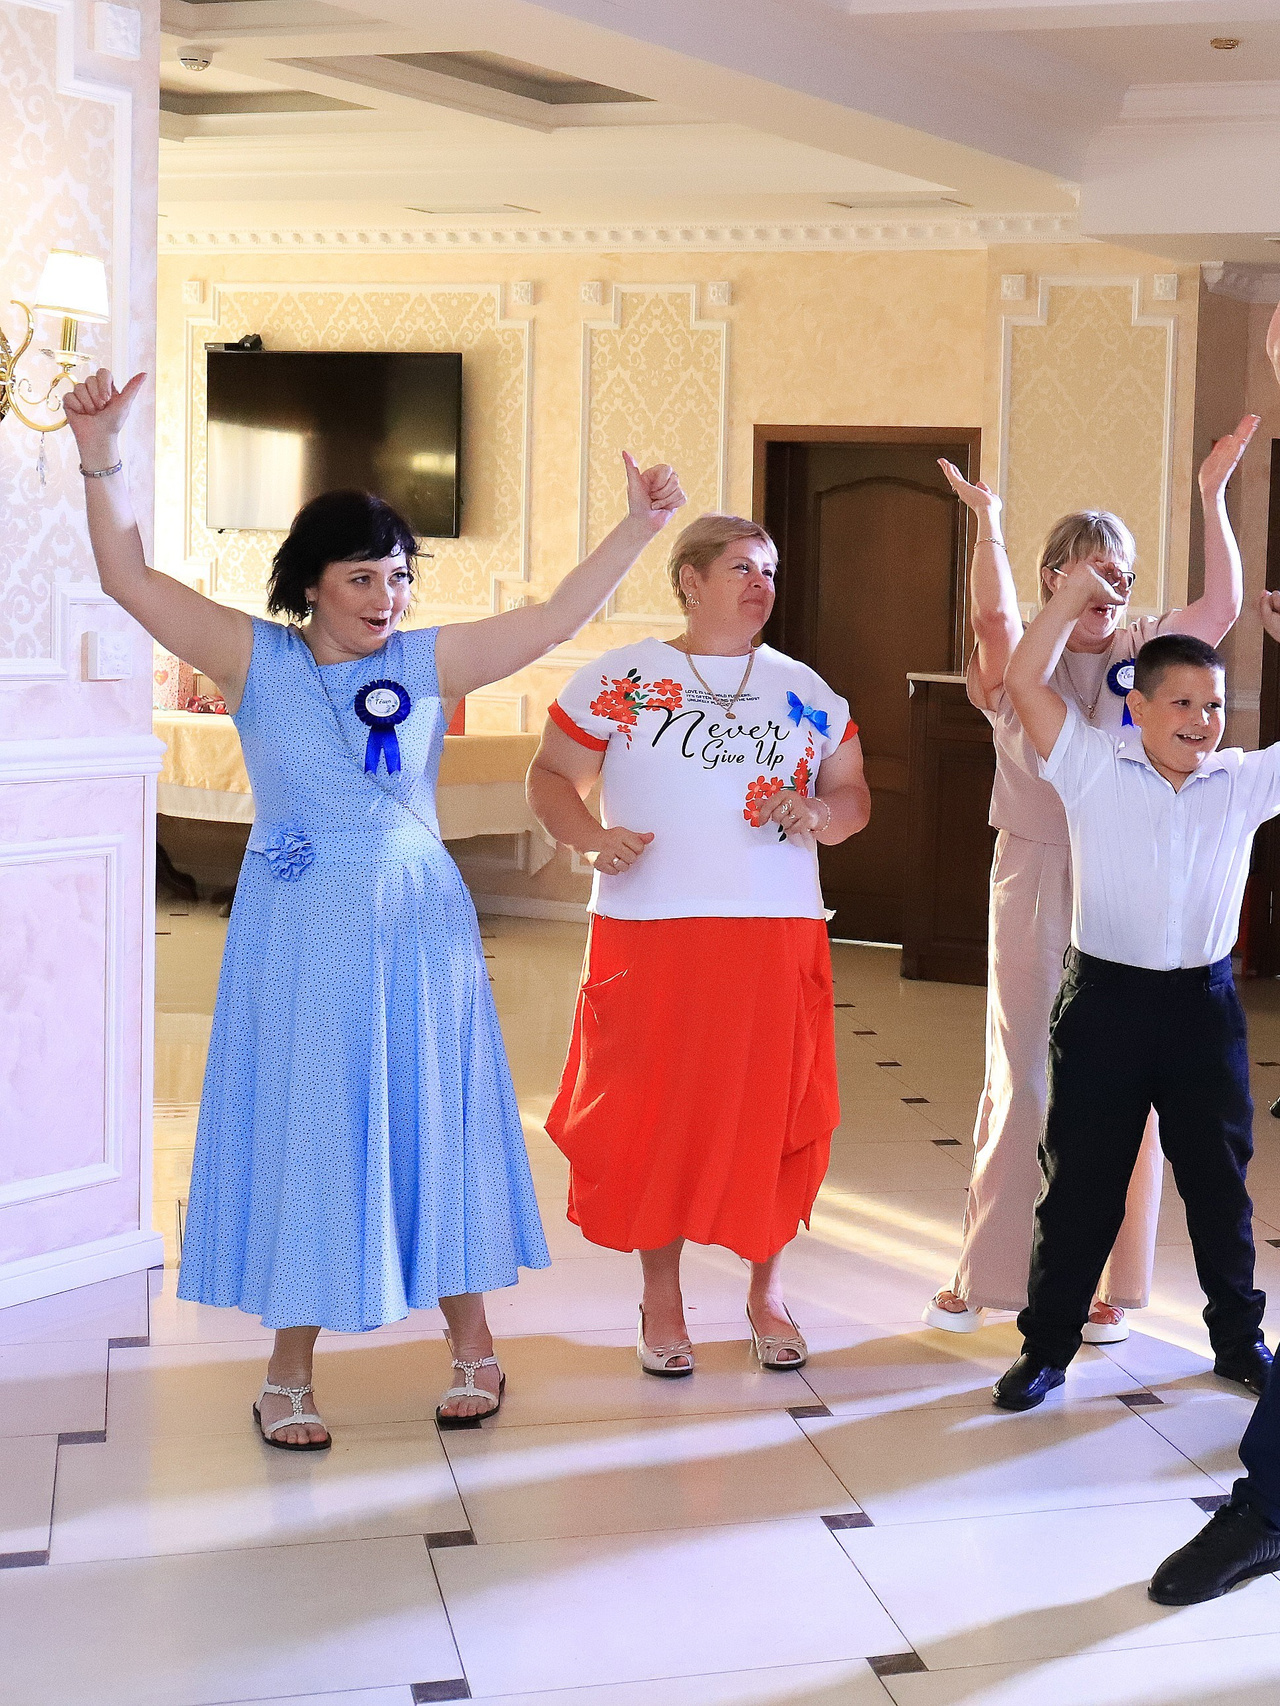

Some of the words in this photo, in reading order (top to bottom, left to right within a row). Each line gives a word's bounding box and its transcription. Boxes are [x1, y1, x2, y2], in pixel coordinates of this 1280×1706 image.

[638, 704, 791, 758] Never
[701, 738, 746, 770] Give
[755, 740, 785, 771] Up
